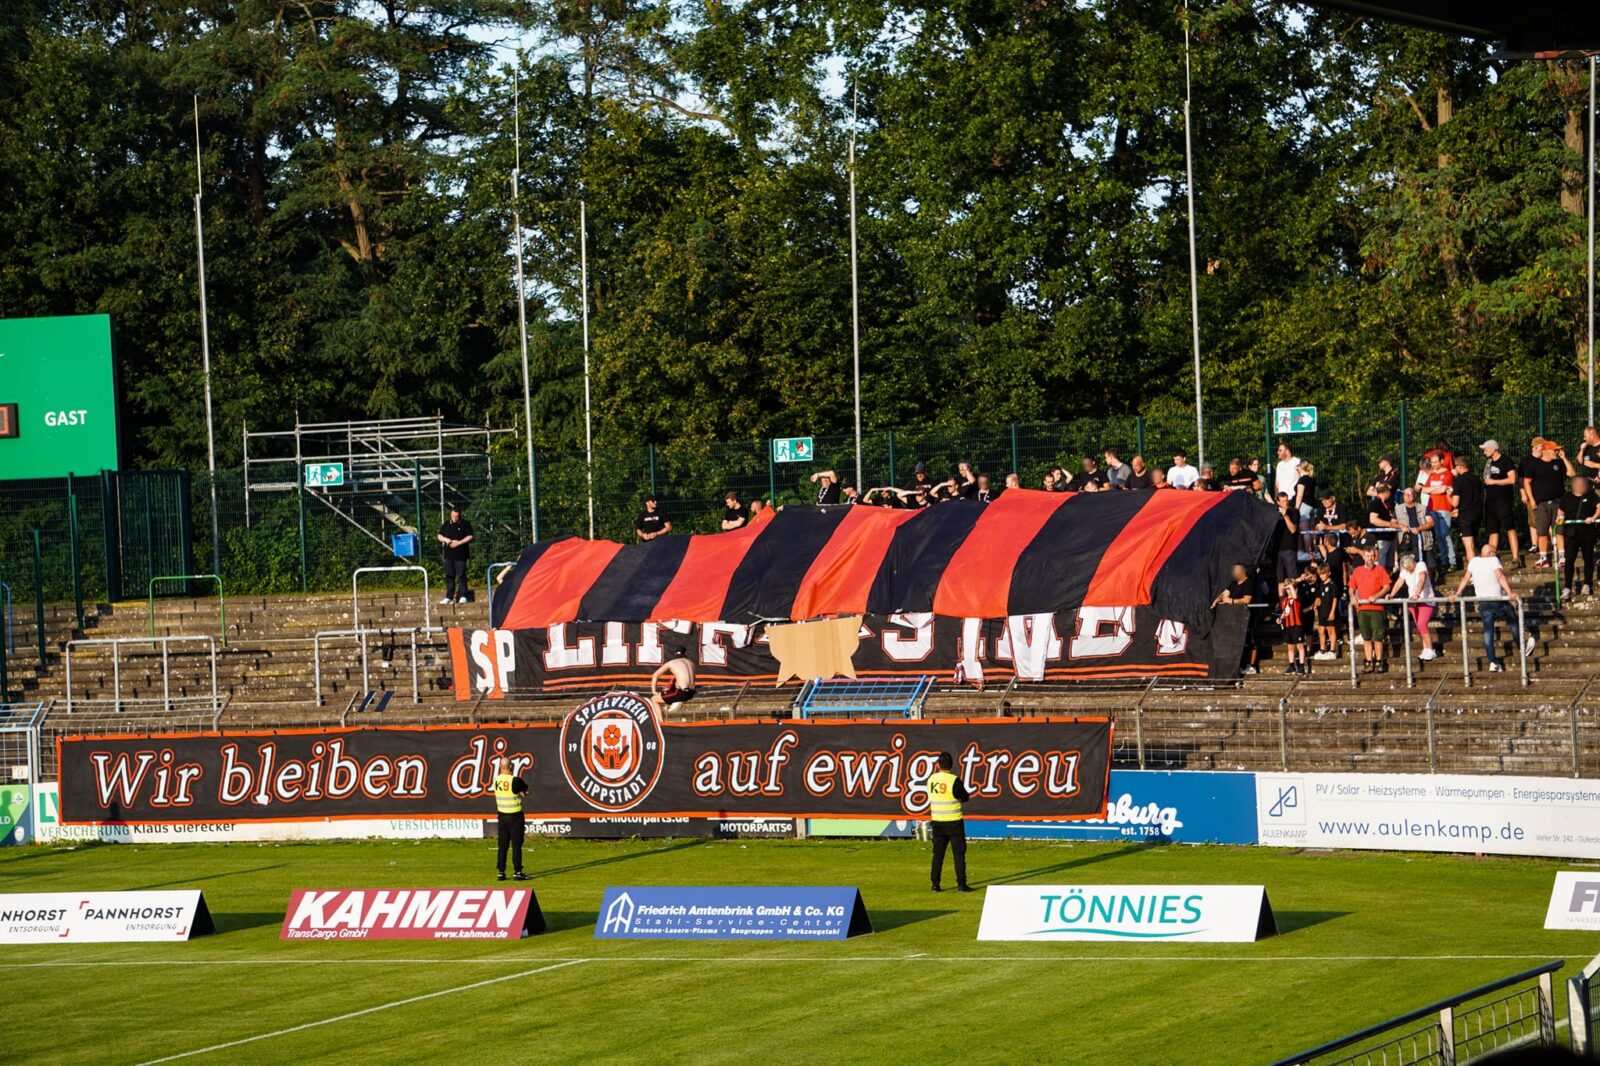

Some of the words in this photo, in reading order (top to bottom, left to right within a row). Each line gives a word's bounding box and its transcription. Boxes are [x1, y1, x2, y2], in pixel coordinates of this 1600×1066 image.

[44, 410, 87, 426] GAST
[470, 630, 516, 694] SP
[575, 696, 650, 726] SPIELVEREIN
[568, 742, 577, 752] 19
[646, 741, 657, 751] 08
[91, 750, 202, 807] Wir
[219, 737, 428, 806] bleiben
[449, 736, 533, 797] dir
[694, 730, 798, 796] auf
[804, 734, 940, 816] ewig
[960, 742, 1080, 798] treu
[495, 780, 510, 791] K9
[580, 774, 647, 804] LIPPSTADT
[930, 782, 947, 794] K9
[1316, 784, 1328, 795] PV
[1337, 784, 1360, 795] Solar
[1368, 785, 1427, 798] Heizsysteme
[40, 824, 130, 837] VERSICHERUNG
[390, 818, 479, 831] VERSICHERUNG
[1121, 826, 1137, 835] est.
[1139, 826, 1160, 836] 1758
[1262, 829, 1307, 838] AULENKAMP
[1319, 819, 1524, 843] www.aulenkamp.de
[288, 890, 526, 928] KAHMEN
[637, 905, 686, 915] Friedrich
[688, 905, 754, 915] Amtenbrink
[756, 905, 791, 916] GmbH
[793, 906, 801, 916] &
[804, 906, 824, 916] Co.
[826, 906, 845, 916] KG
[1039, 888, 1204, 924] TÖNNIES
[0, 909, 66, 921] NHORST
[85, 907, 184, 920] PANNHORST
[9, 925, 60, 933] ENTSORGUNG
[126, 923, 177, 931] ENTSORGUNG
[730, 927, 774, 935] Baugruppen
[288, 928, 338, 940] TransCargo
[339, 928, 369, 938] GmbH
[434, 929, 508, 938] www.kahmen.de
